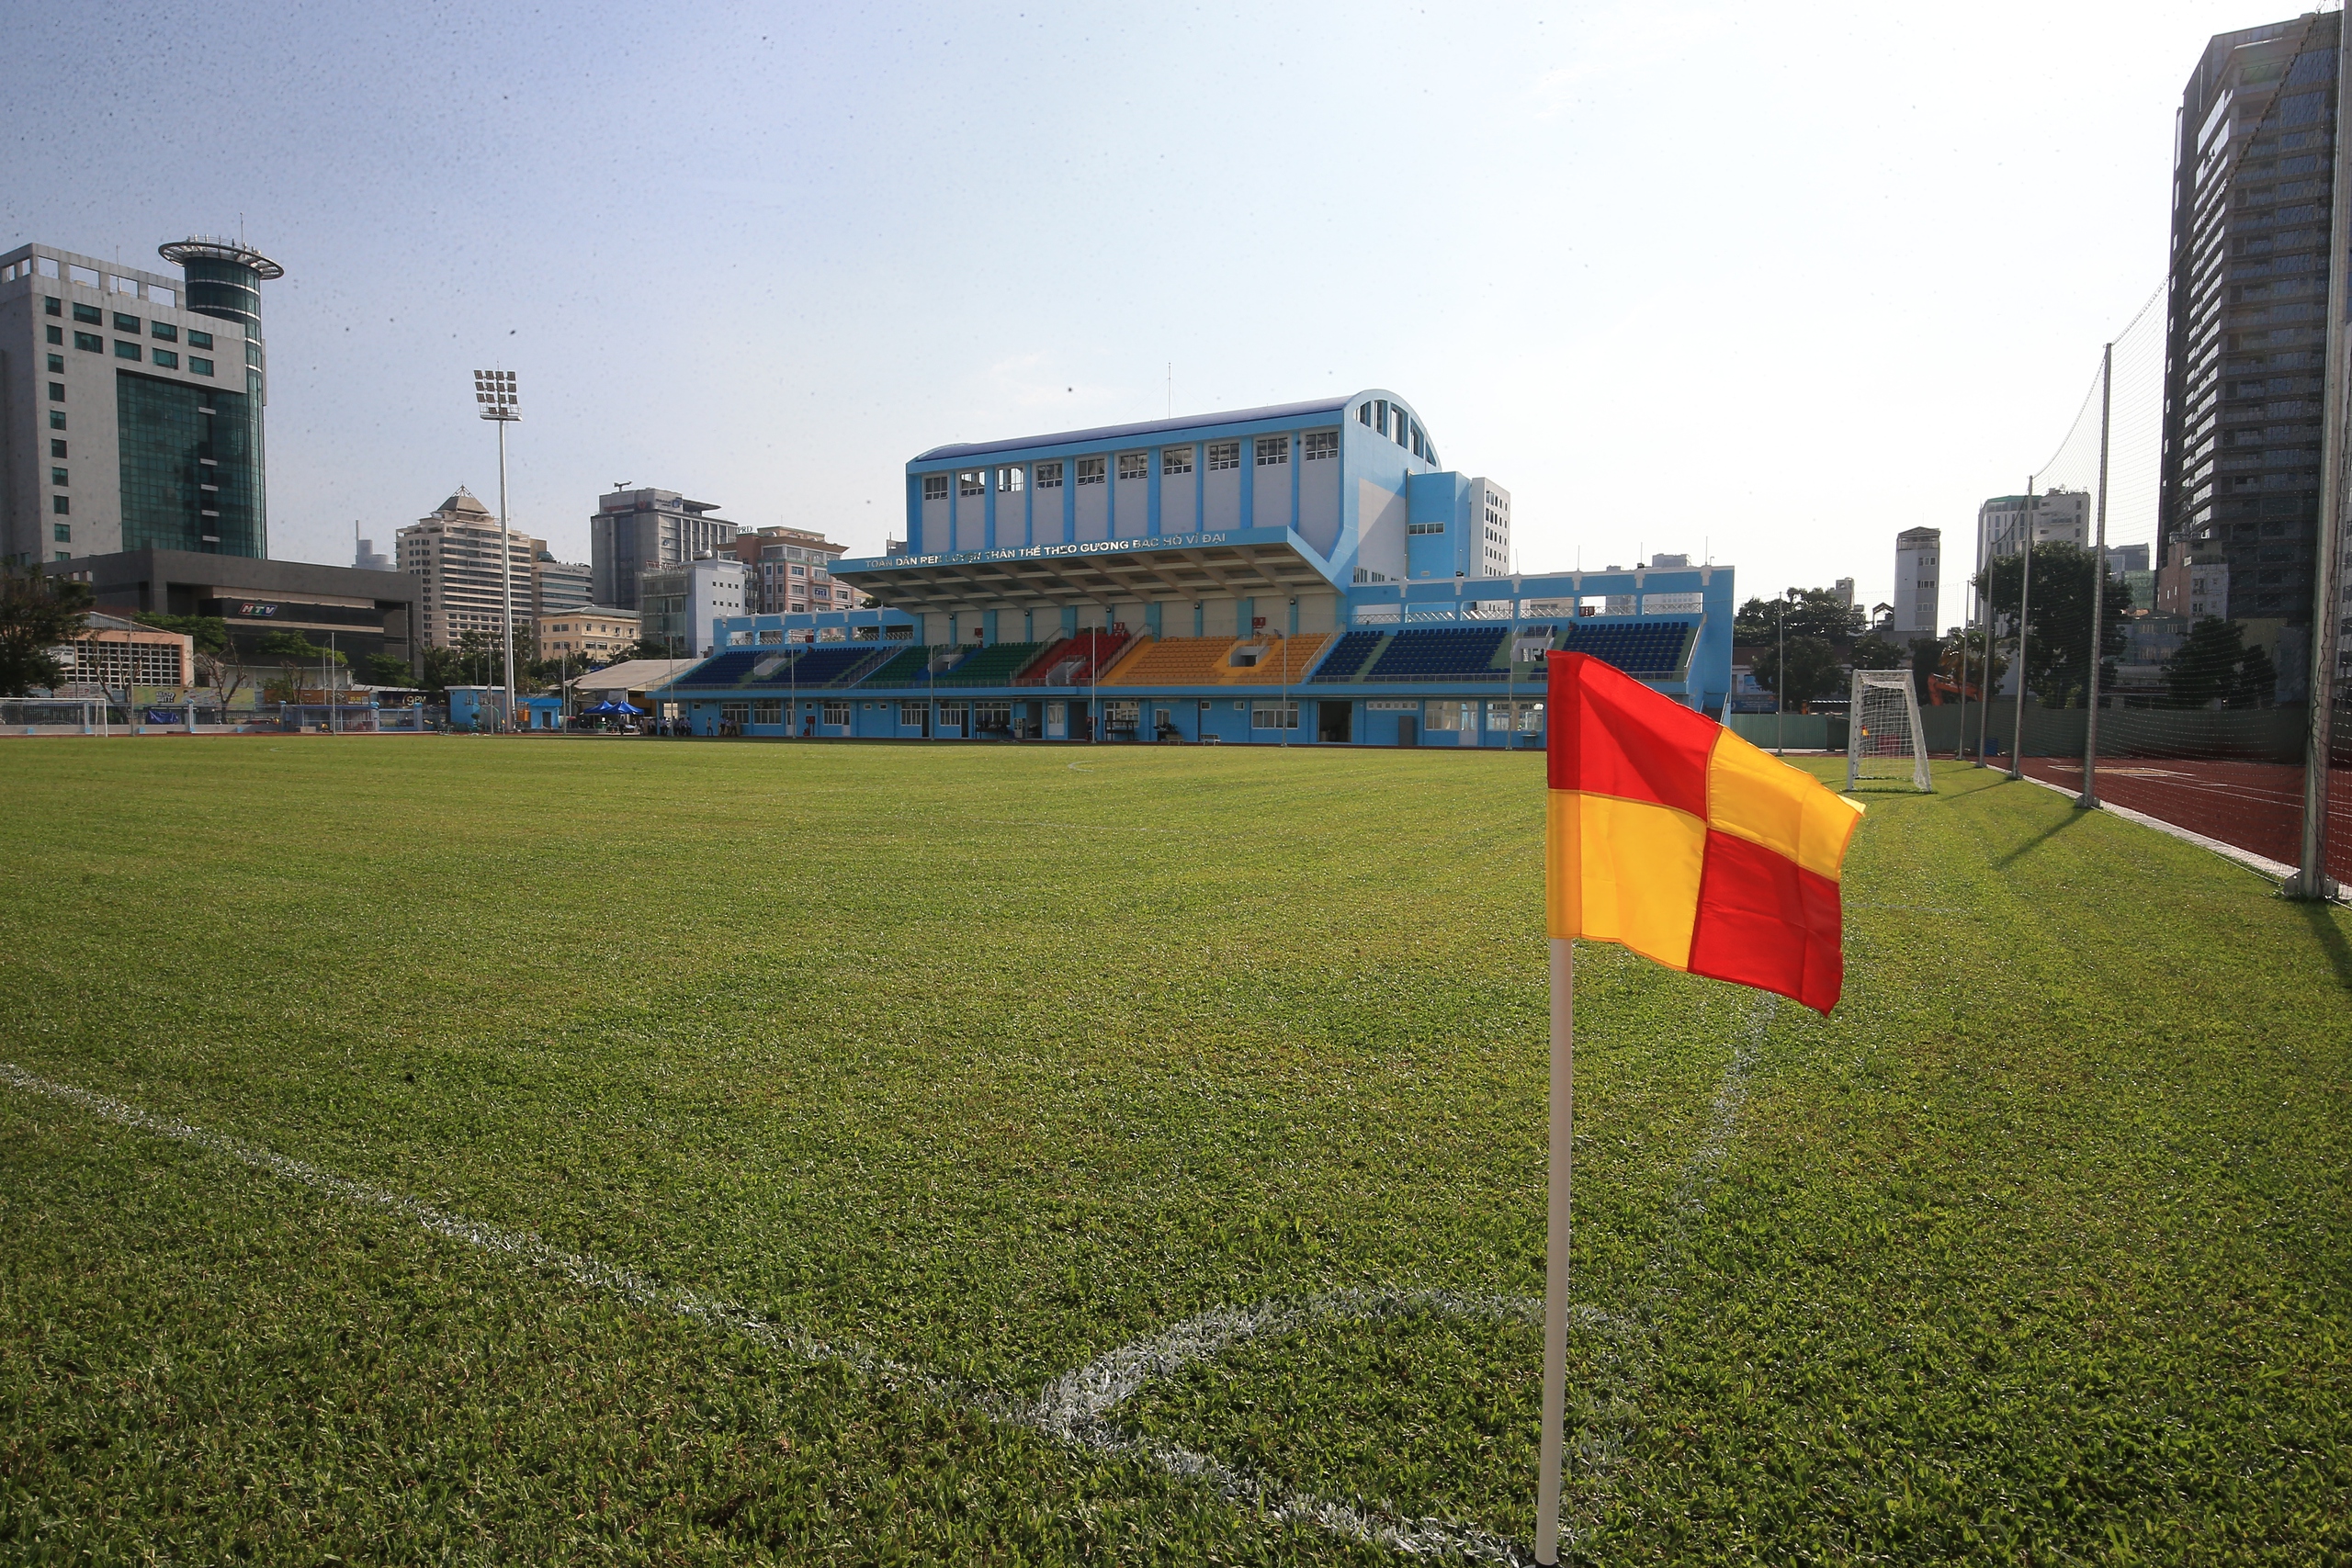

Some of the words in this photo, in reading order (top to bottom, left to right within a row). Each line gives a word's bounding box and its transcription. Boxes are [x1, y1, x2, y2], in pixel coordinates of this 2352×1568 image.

[865, 558, 893, 568] TOÀN
[1044, 545, 1078, 556] THEO
[1202, 533, 1226, 545] ĐẠI
[242, 604, 275, 615] HTV
